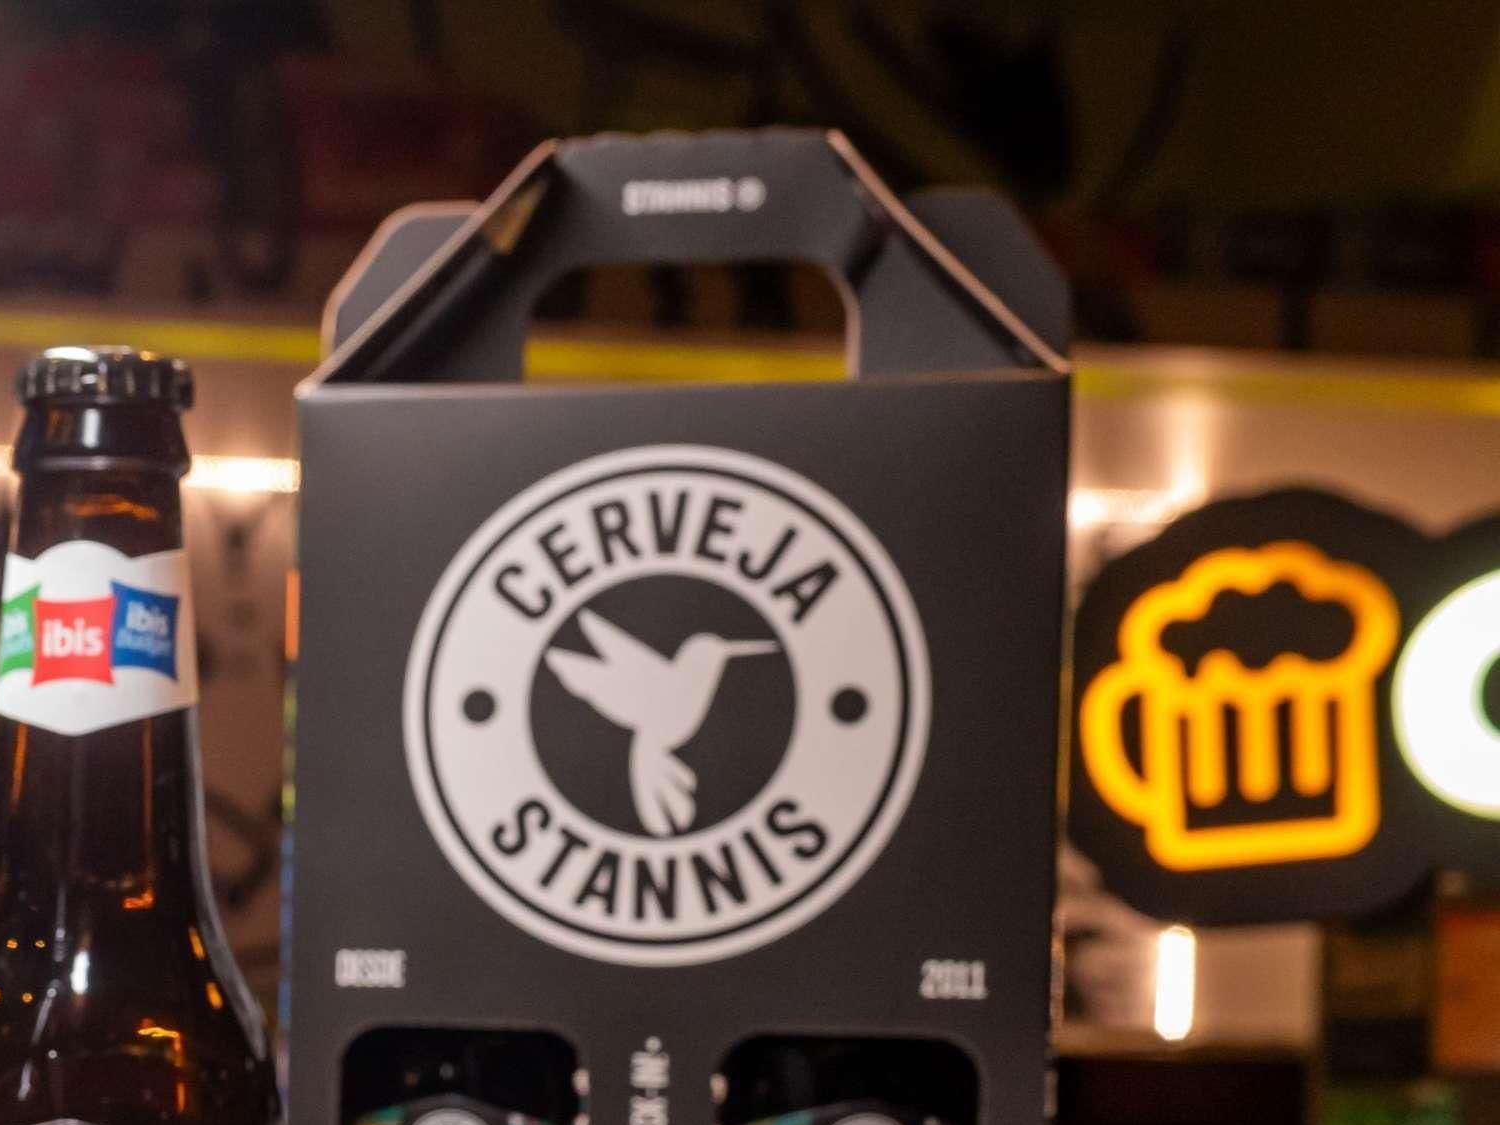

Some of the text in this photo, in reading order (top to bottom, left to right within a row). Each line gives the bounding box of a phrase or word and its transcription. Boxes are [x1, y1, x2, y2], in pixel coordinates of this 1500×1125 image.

[492, 490, 840, 624] CERVEJA
[42, 617, 104, 657] ibis
[491, 797, 830, 922] STANNIS
